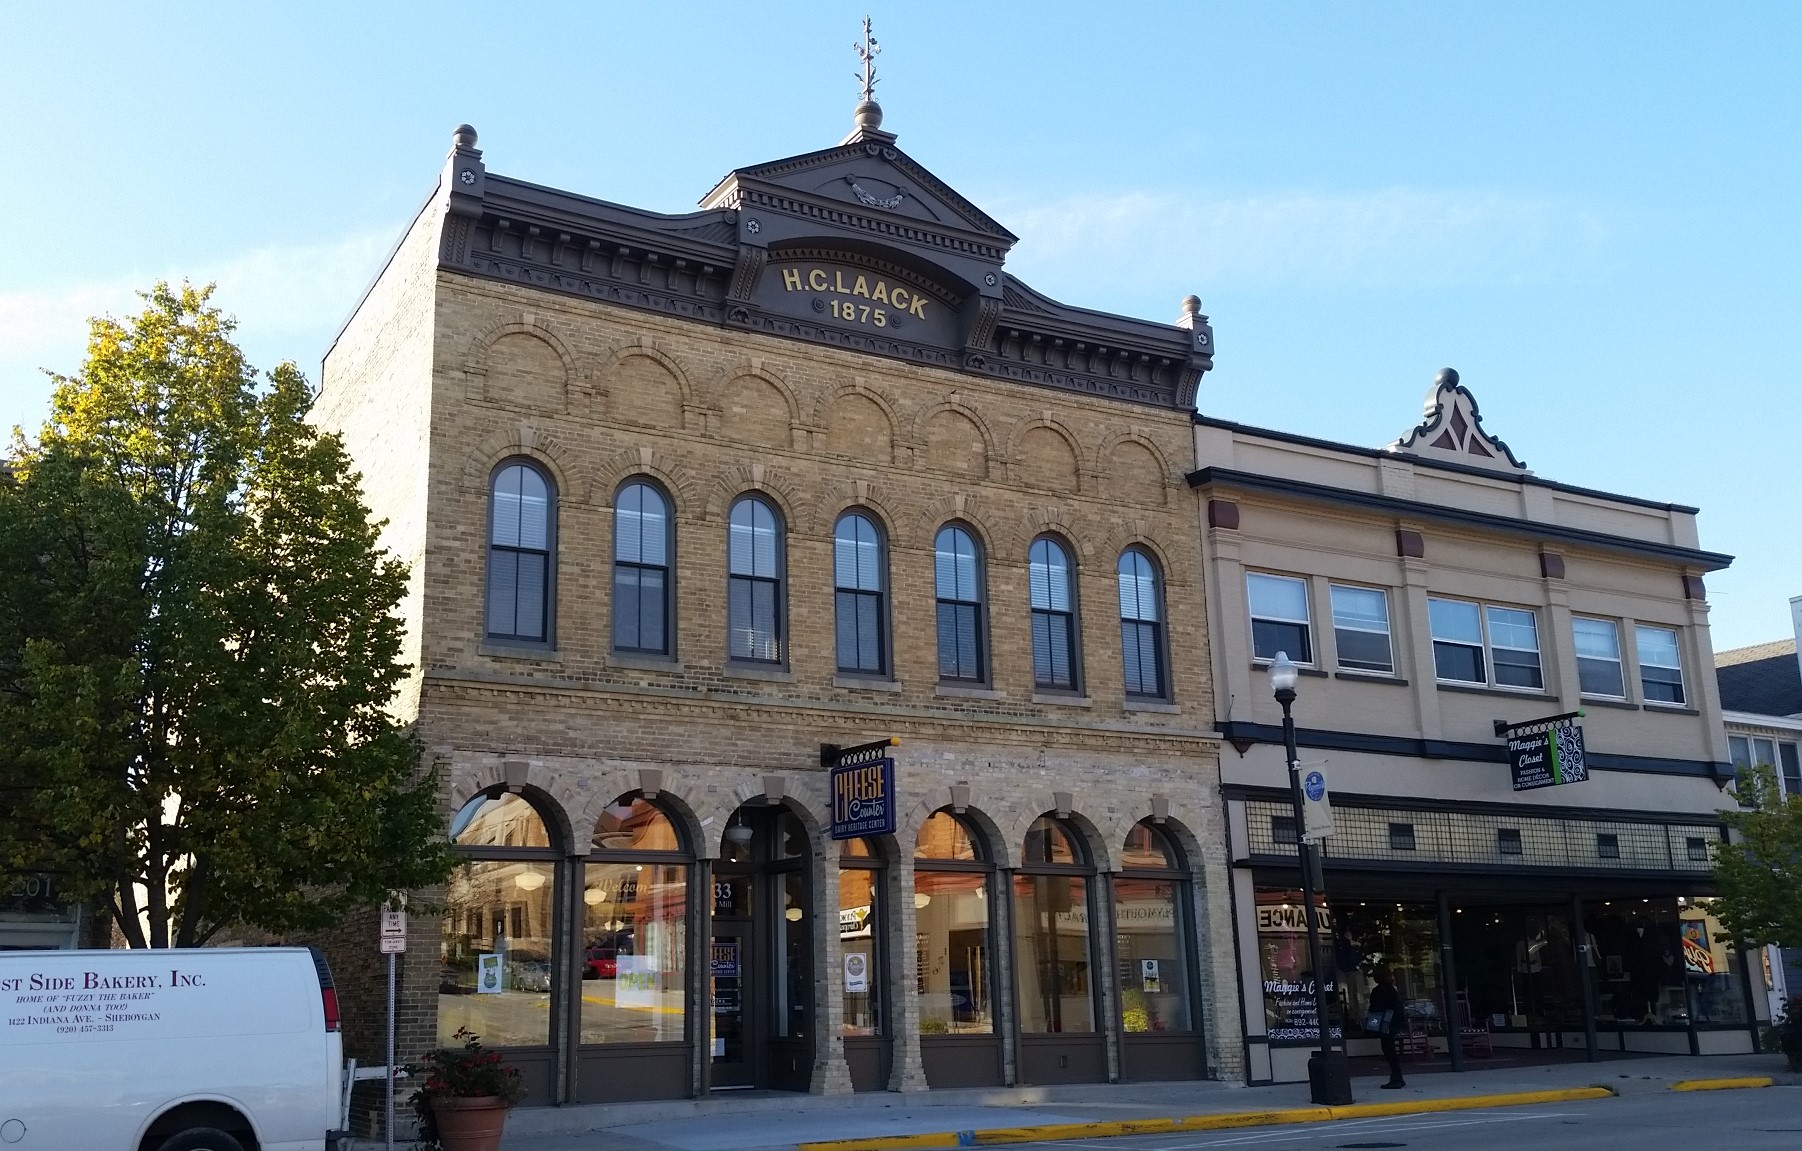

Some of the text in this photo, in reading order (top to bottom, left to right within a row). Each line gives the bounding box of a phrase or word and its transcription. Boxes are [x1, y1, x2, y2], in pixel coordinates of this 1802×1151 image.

[830, 299, 886, 328] 1875
[1508, 735, 1549, 752] Maggie's
[1519, 752, 1543, 768] Closet
[834, 764, 885, 824] CHEESE
[848, 799, 885, 821] Counter
[719, 900, 732, 908] Mill
[388, 920, 400, 928] TIME
[0, 969, 206, 992] ST SIDE BAKERY, INC.
[1264, 980, 1307, 996] Maggie's
[16, 995, 43, 1003] HOME
[46, 995, 59, 1003] OF
[98, 993, 117, 1001] THE
[43, 1004, 67, 1013] (AND
[69, 1003, 101, 1013] DONNA
[8, 1018, 26, 1026] 1422
[27, 1015, 70, 1025] INDIANA
[72, 1014, 94, 1024] AVE.
[105, 1013, 161, 1022] SHEBOYGAN
[56, 1024, 114, 1034] (920) 457-3313
